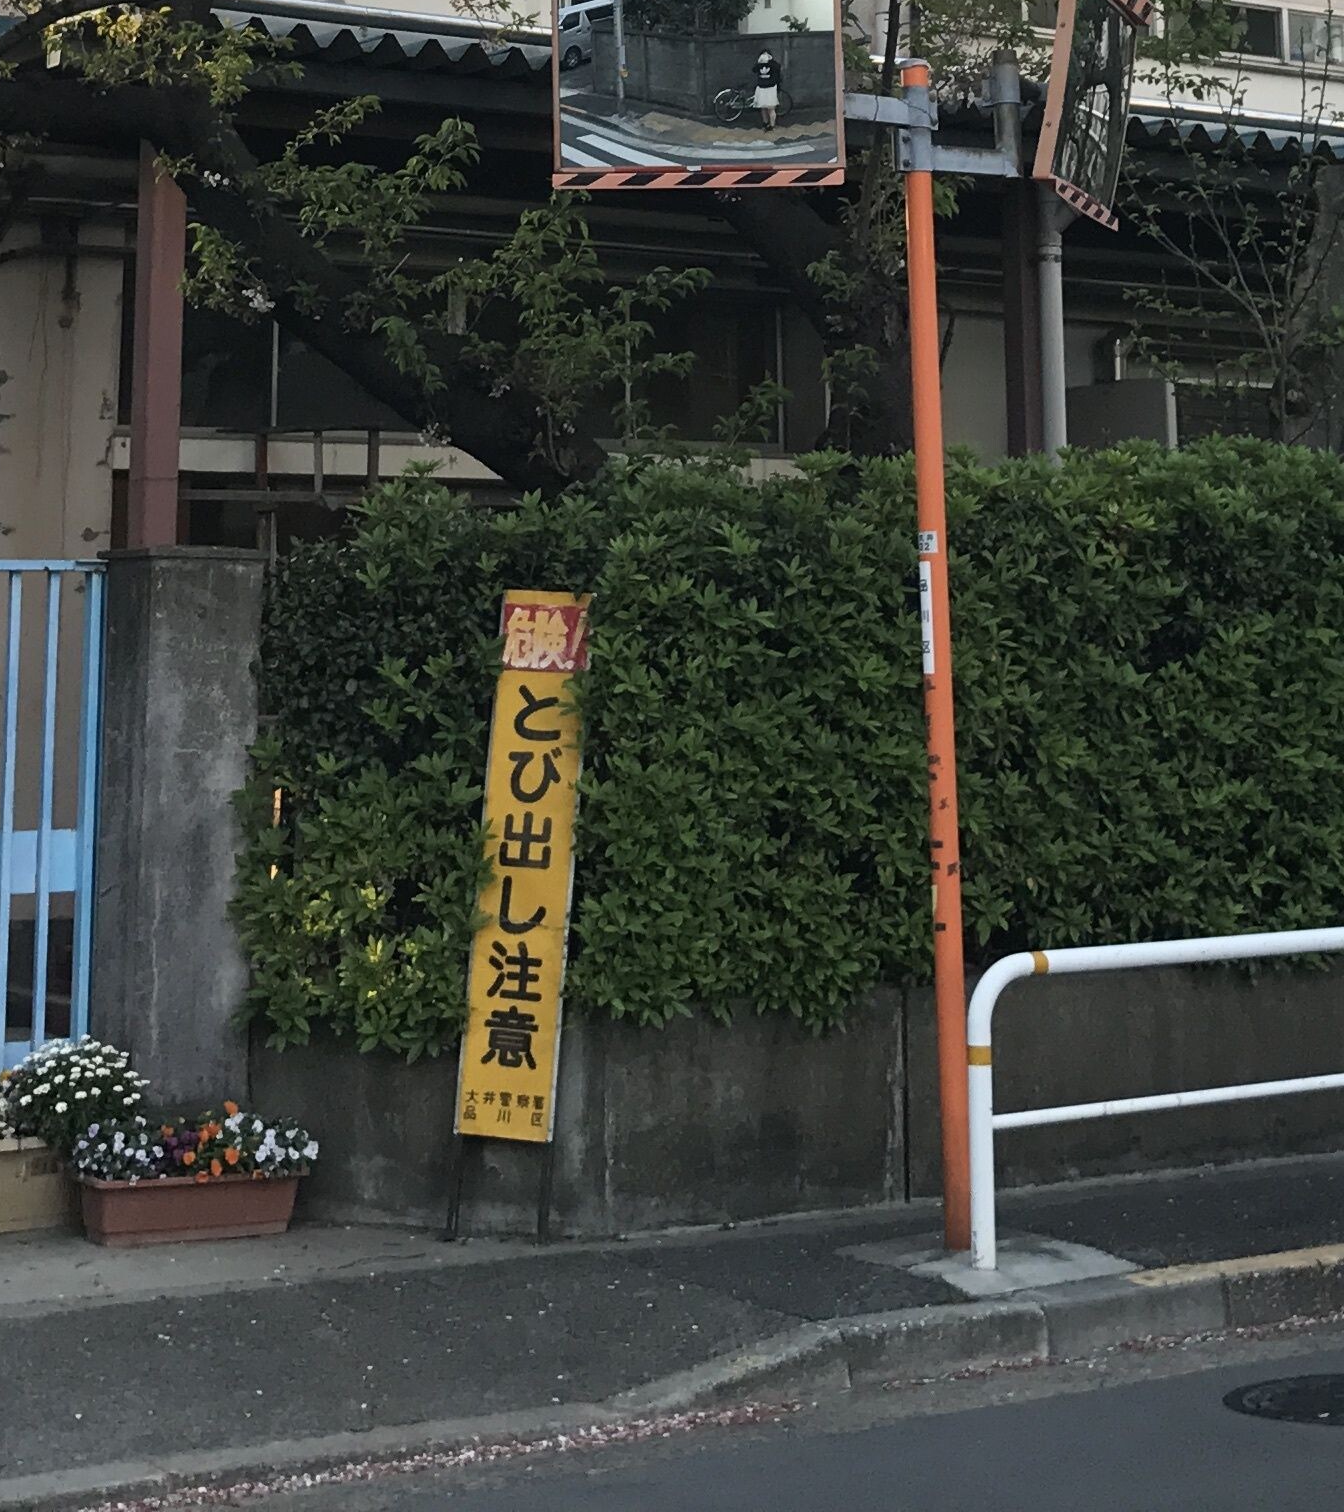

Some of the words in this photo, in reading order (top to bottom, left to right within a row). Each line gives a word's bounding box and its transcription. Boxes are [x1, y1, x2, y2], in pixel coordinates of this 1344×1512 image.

[481, 684, 563, 1070] とび出し注意
[464, 1089, 545, 1110] 大井警察署
[463, 1105, 544, 1128] 品川区
